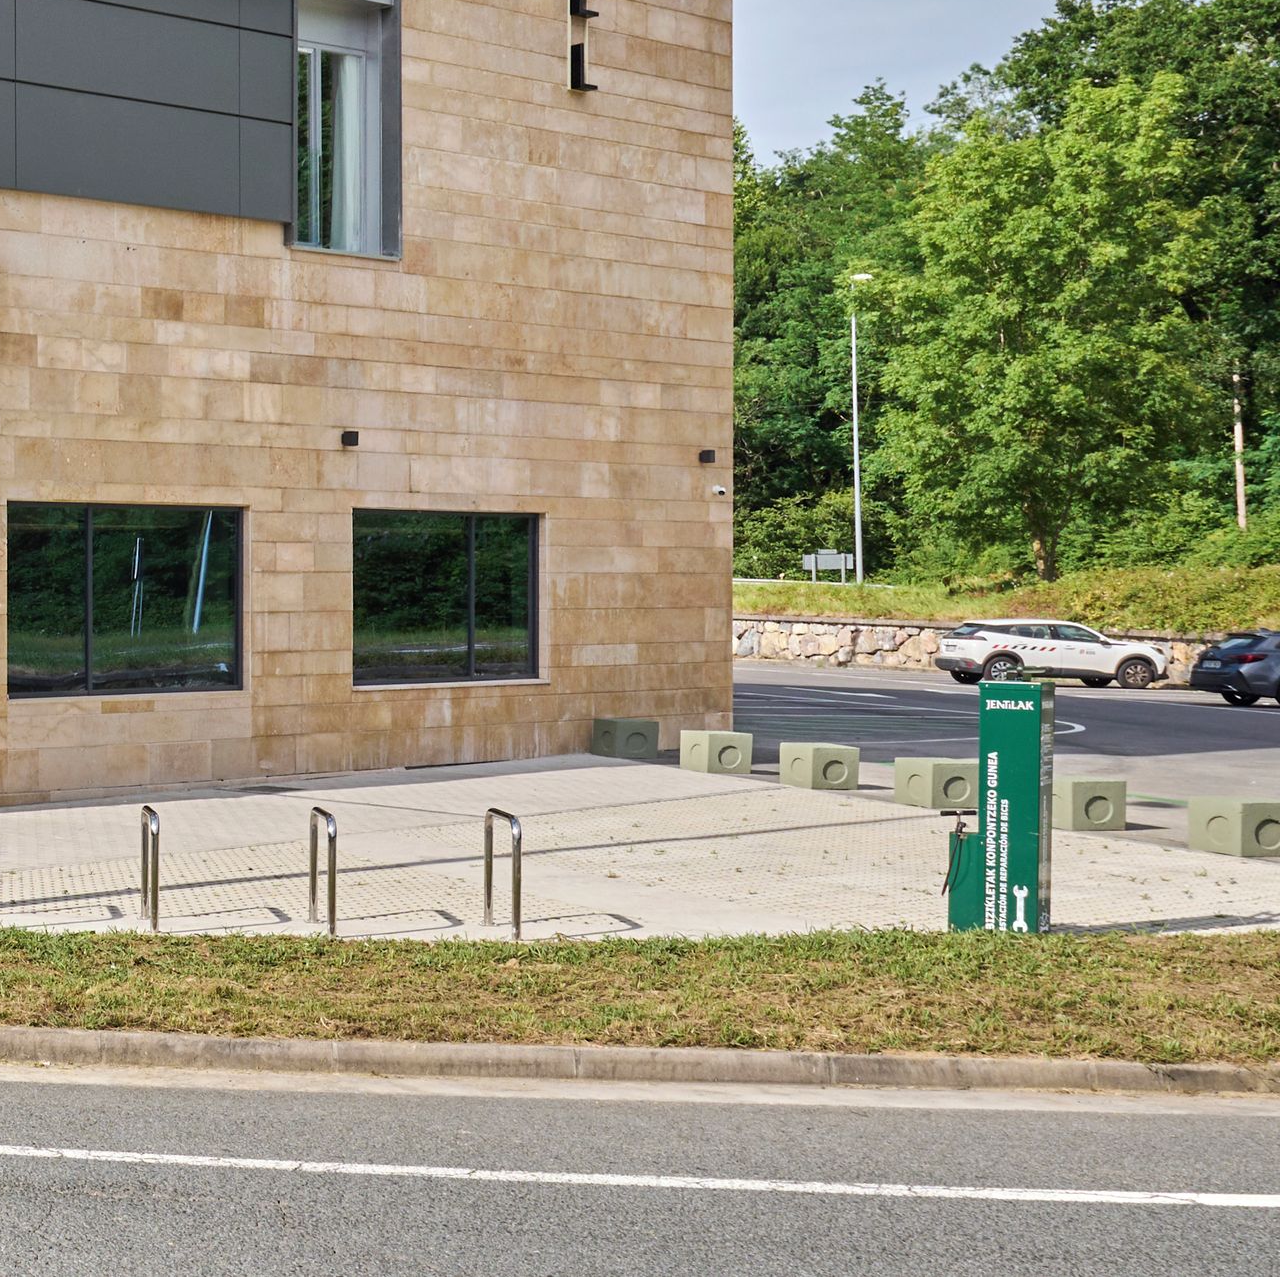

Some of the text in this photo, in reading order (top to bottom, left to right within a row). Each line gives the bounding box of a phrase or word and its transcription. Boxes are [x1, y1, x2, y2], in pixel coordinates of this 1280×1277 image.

[987, 751, 998, 788] GUNEA
[985, 789, 997, 867] KONPONTZEKO
[998, 799, 1009, 932] ESTACIÓN DE REPARACIÓN DE BICIS
